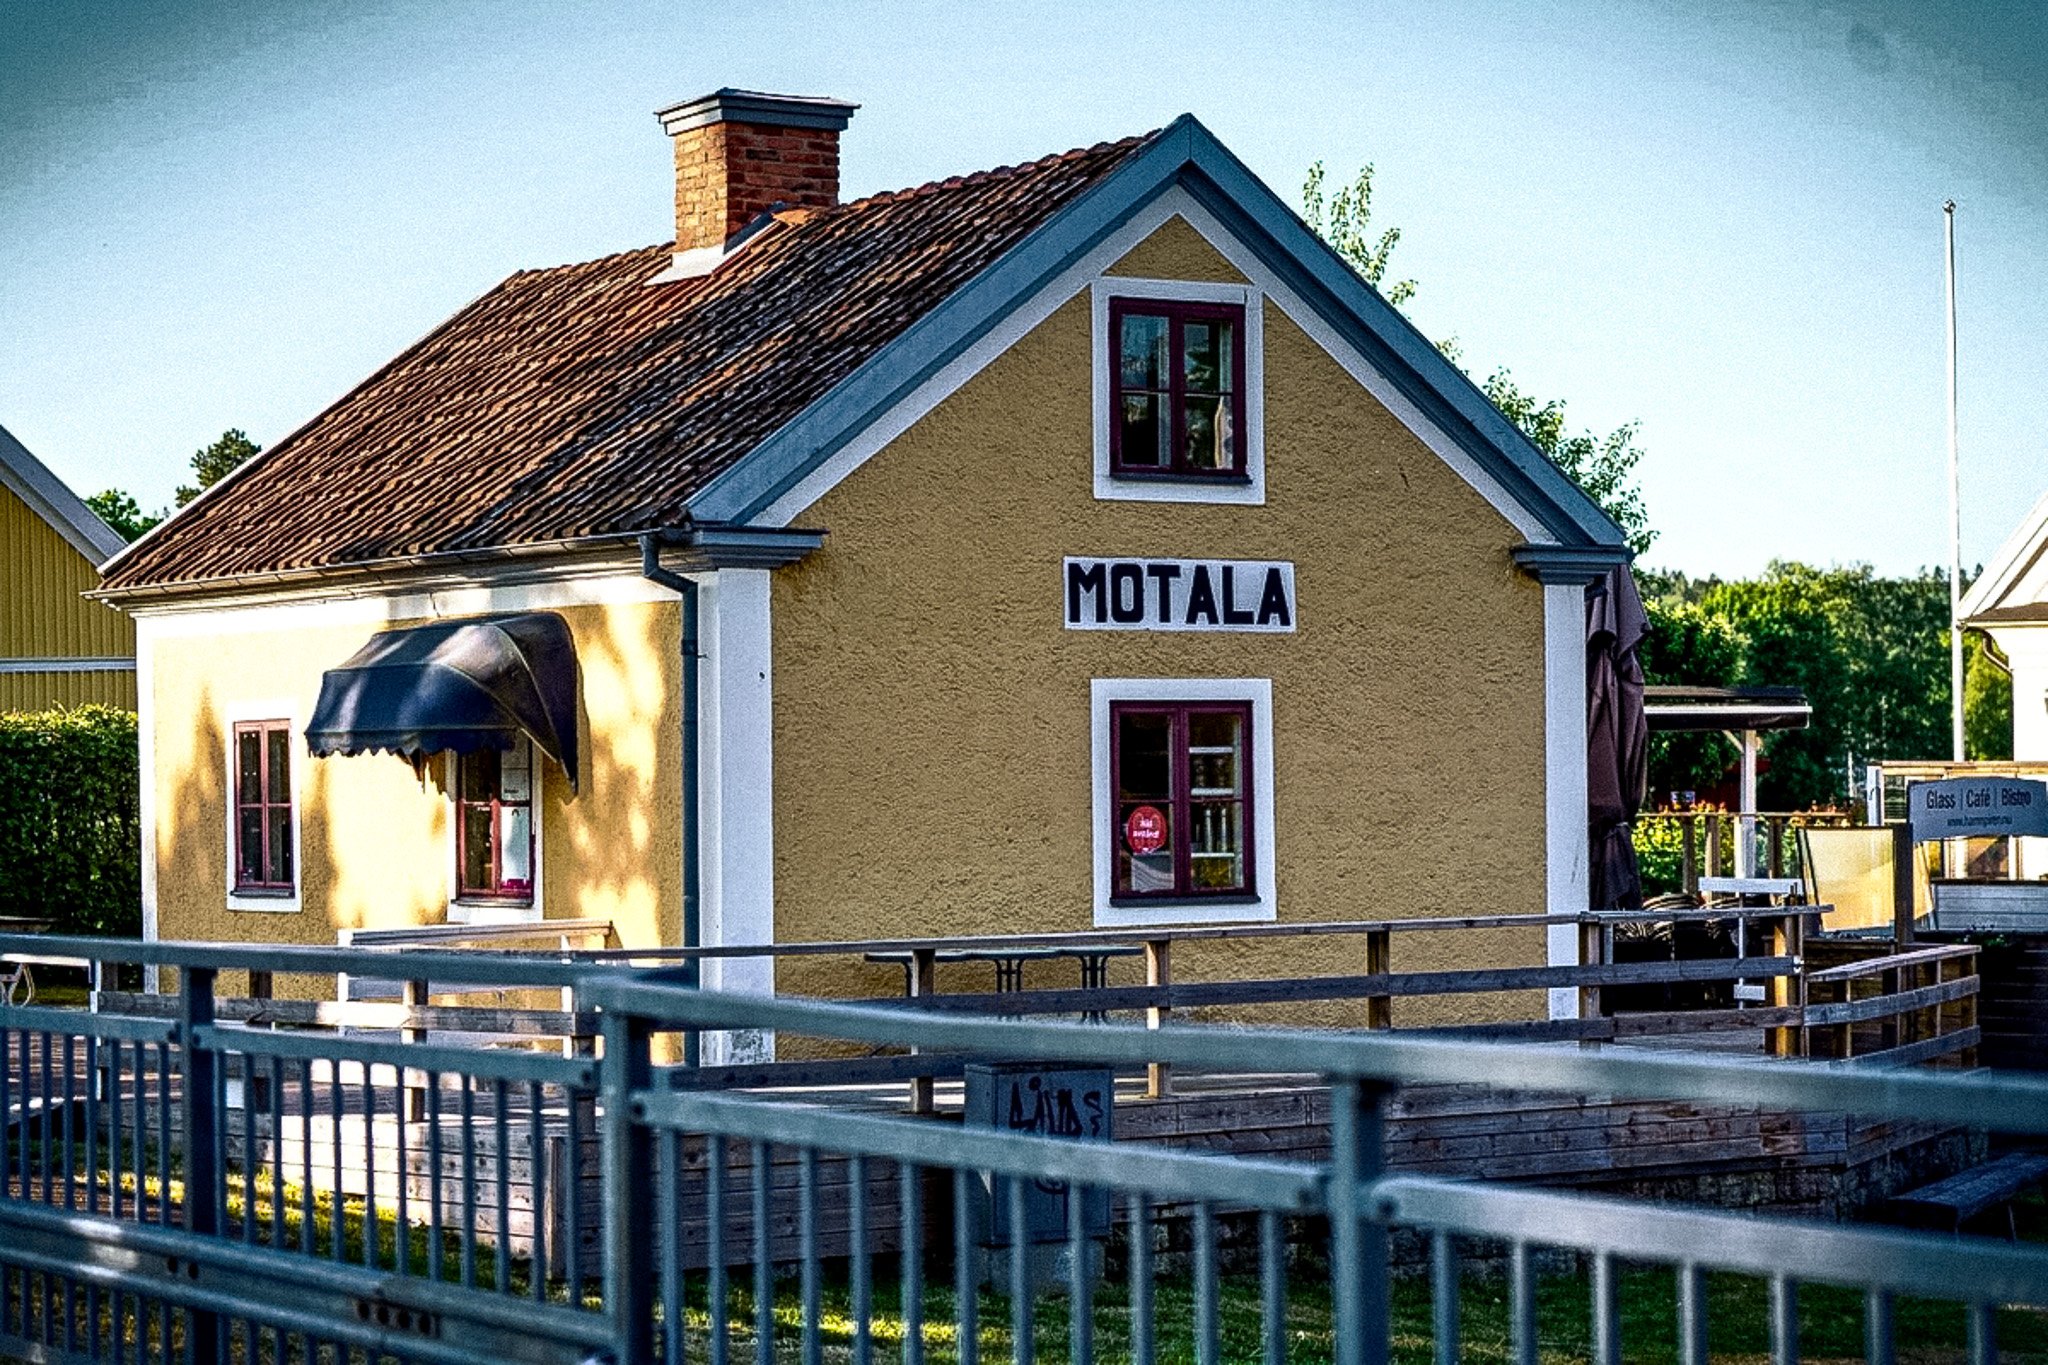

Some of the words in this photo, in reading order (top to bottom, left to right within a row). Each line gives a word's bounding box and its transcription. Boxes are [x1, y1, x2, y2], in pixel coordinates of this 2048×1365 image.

[1068, 562, 1291, 627] MOTALA
[1926, 789, 1956, 809] Glass
[1965, 787, 1991, 808] Café
[2001, 787, 2032, 808] Bistro
